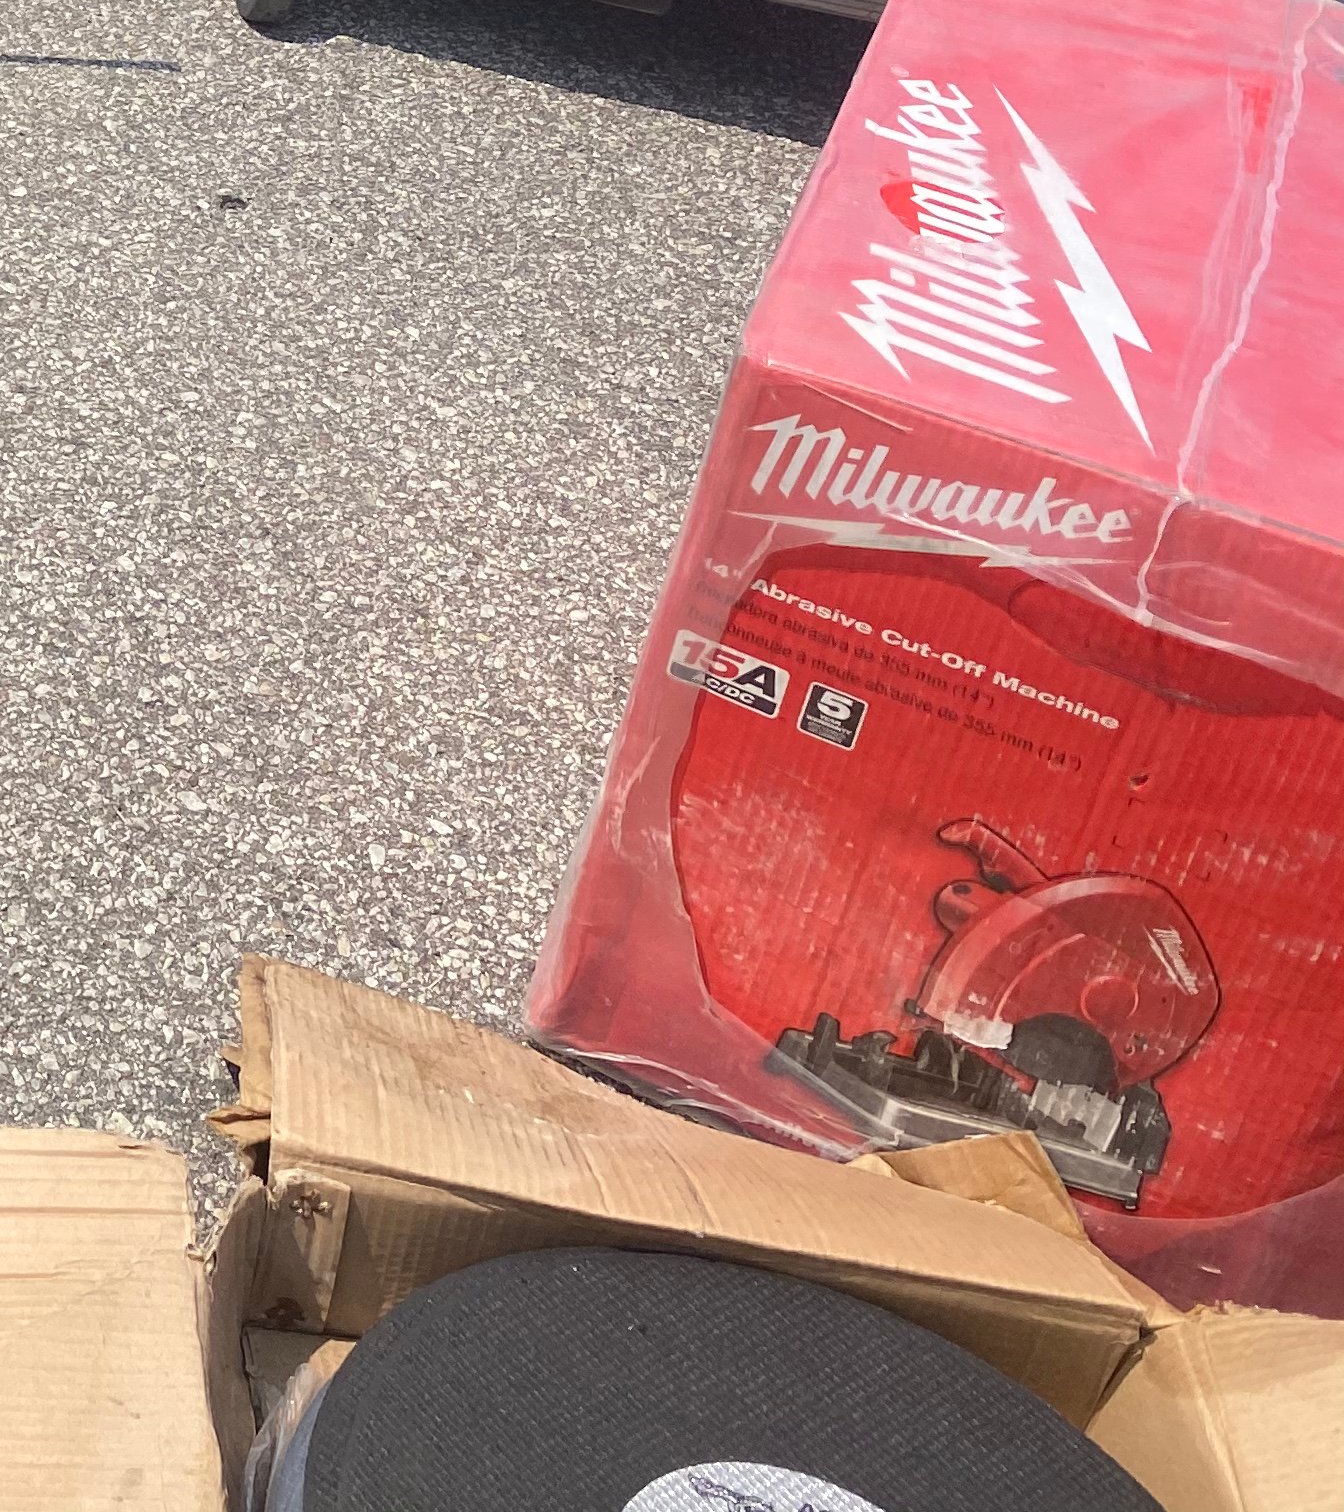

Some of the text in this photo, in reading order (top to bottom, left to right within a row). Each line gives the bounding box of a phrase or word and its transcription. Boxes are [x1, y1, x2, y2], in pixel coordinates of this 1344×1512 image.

[837, 79, 1073, 404] Milwaukee
[746, 414, 1133, 544] Milwaukee
[681, 640, 778, 700] 15A
[691, 672, 757, 705] AC/DC
[750, 578, 874, 636] Abrasive
[880, 629, 987, 679] Cut-Off
[992, 671, 1120, 731] Machine
[782, 617, 850, 654] abrasiva
[915, 669, 949, 693] mm
[816, 689, 854, 722] 5
[1000, 728, 1035, 754] mm
